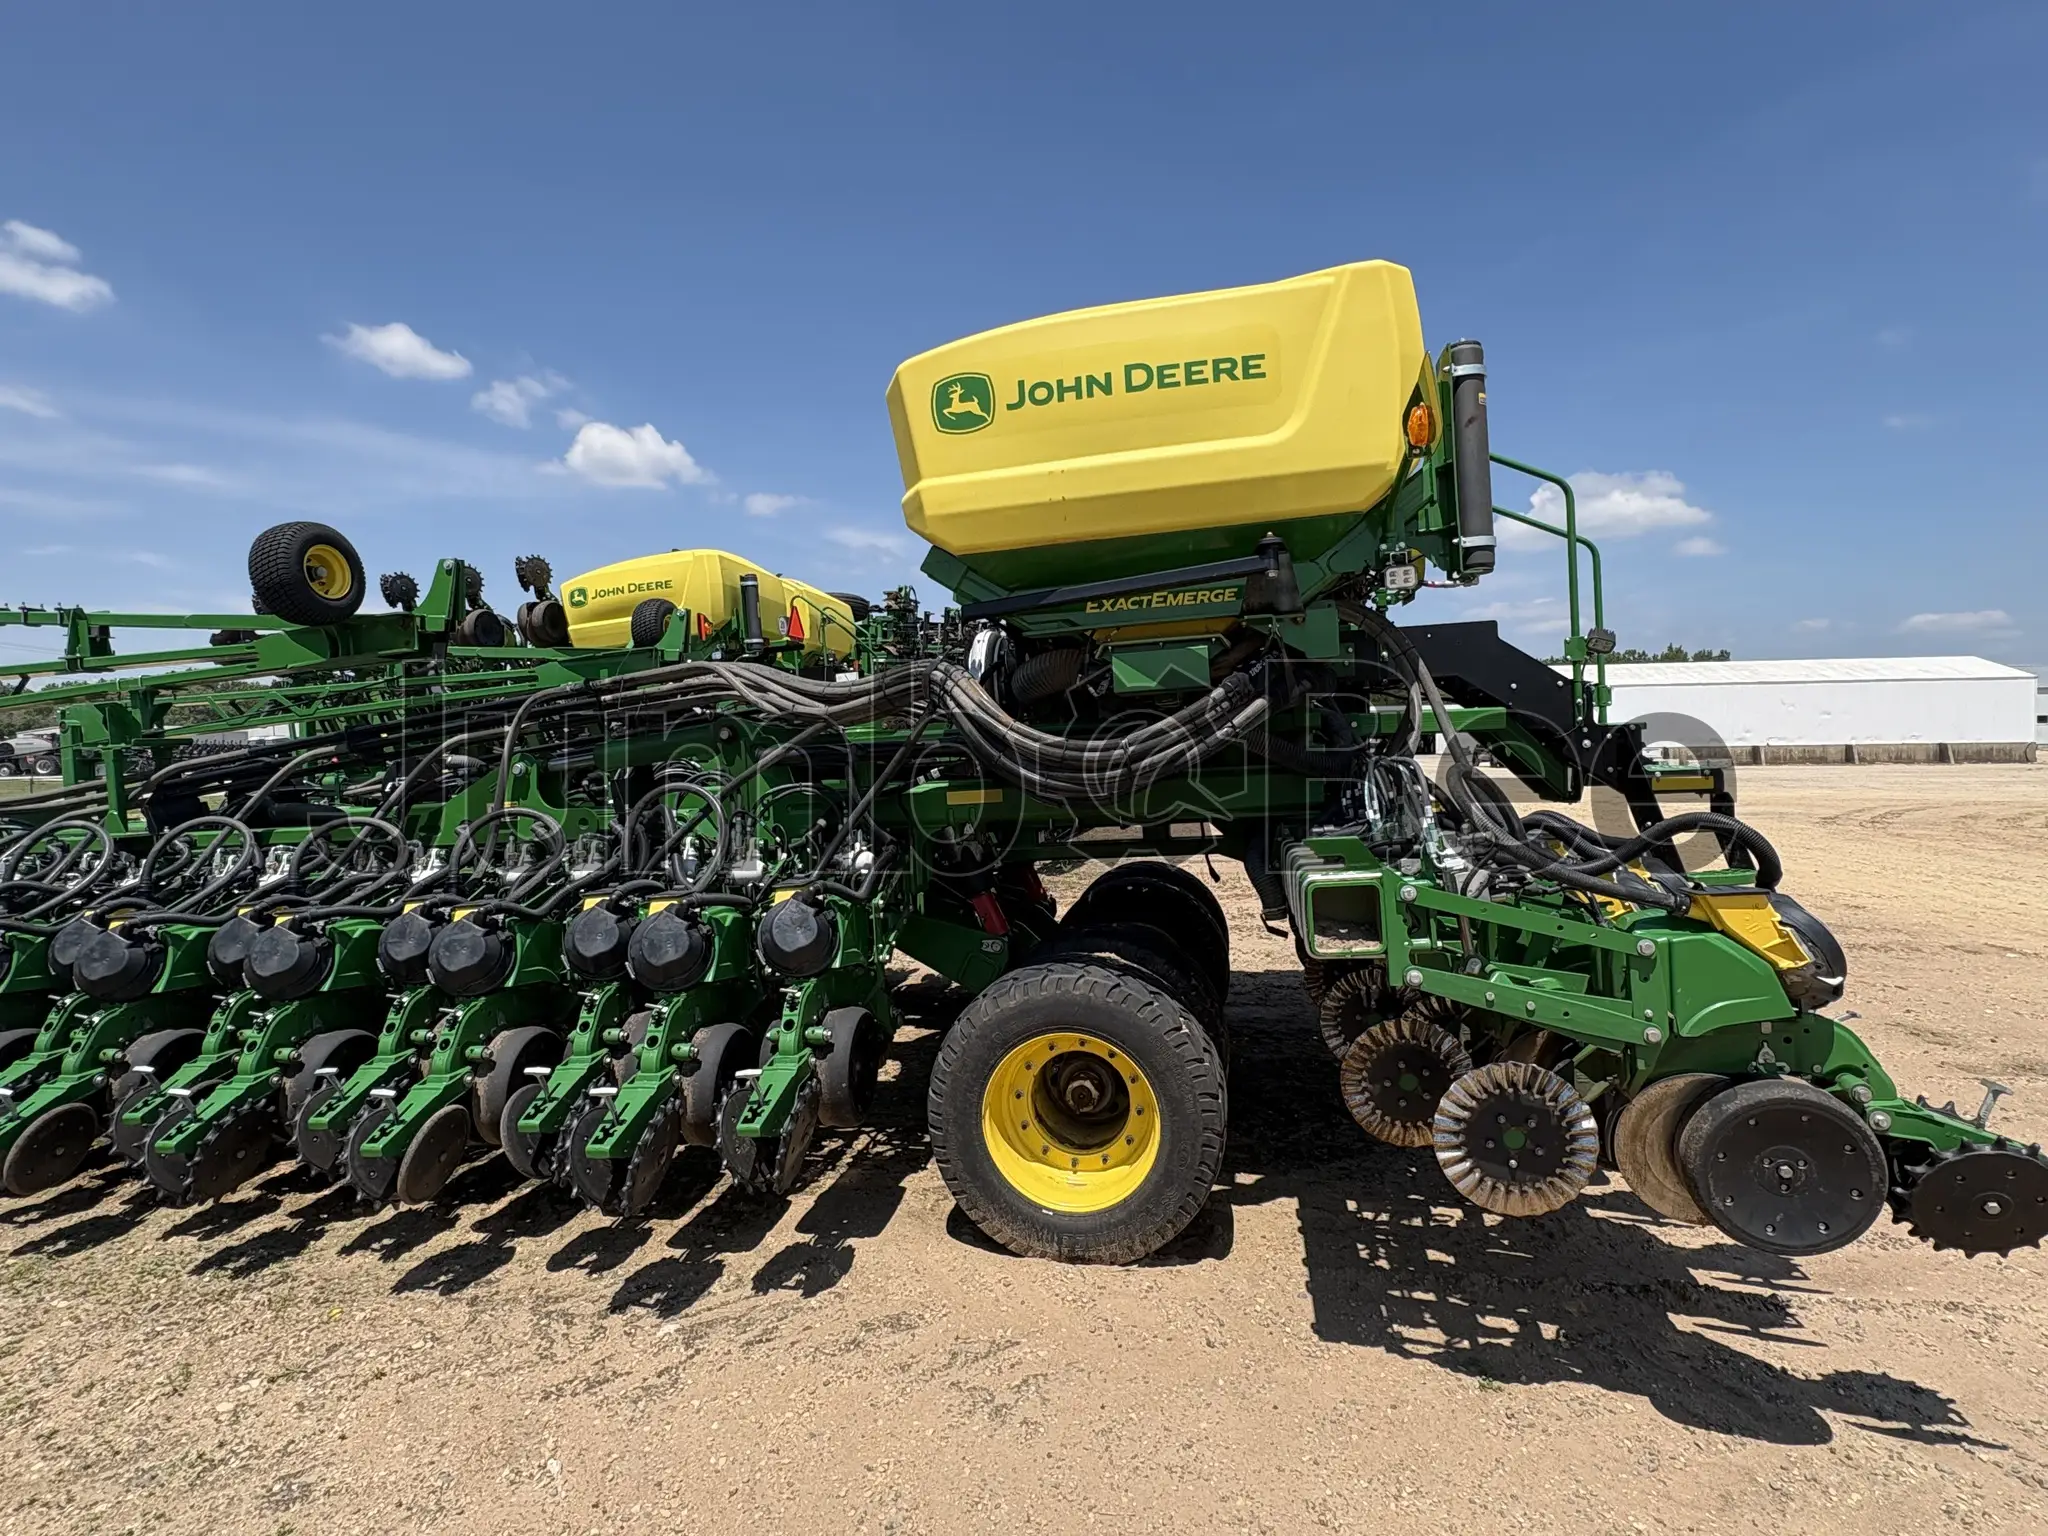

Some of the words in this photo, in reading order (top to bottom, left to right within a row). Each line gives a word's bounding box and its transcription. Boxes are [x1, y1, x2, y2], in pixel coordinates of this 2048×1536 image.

[1006, 371, 1113, 411] JOHN
[1123, 353, 1267, 394] DEERE
[591, 585, 625, 600] JOHN
[627, 579, 673, 594] DEERE
[1085, 588, 1238, 614] EXACTEMERGE
